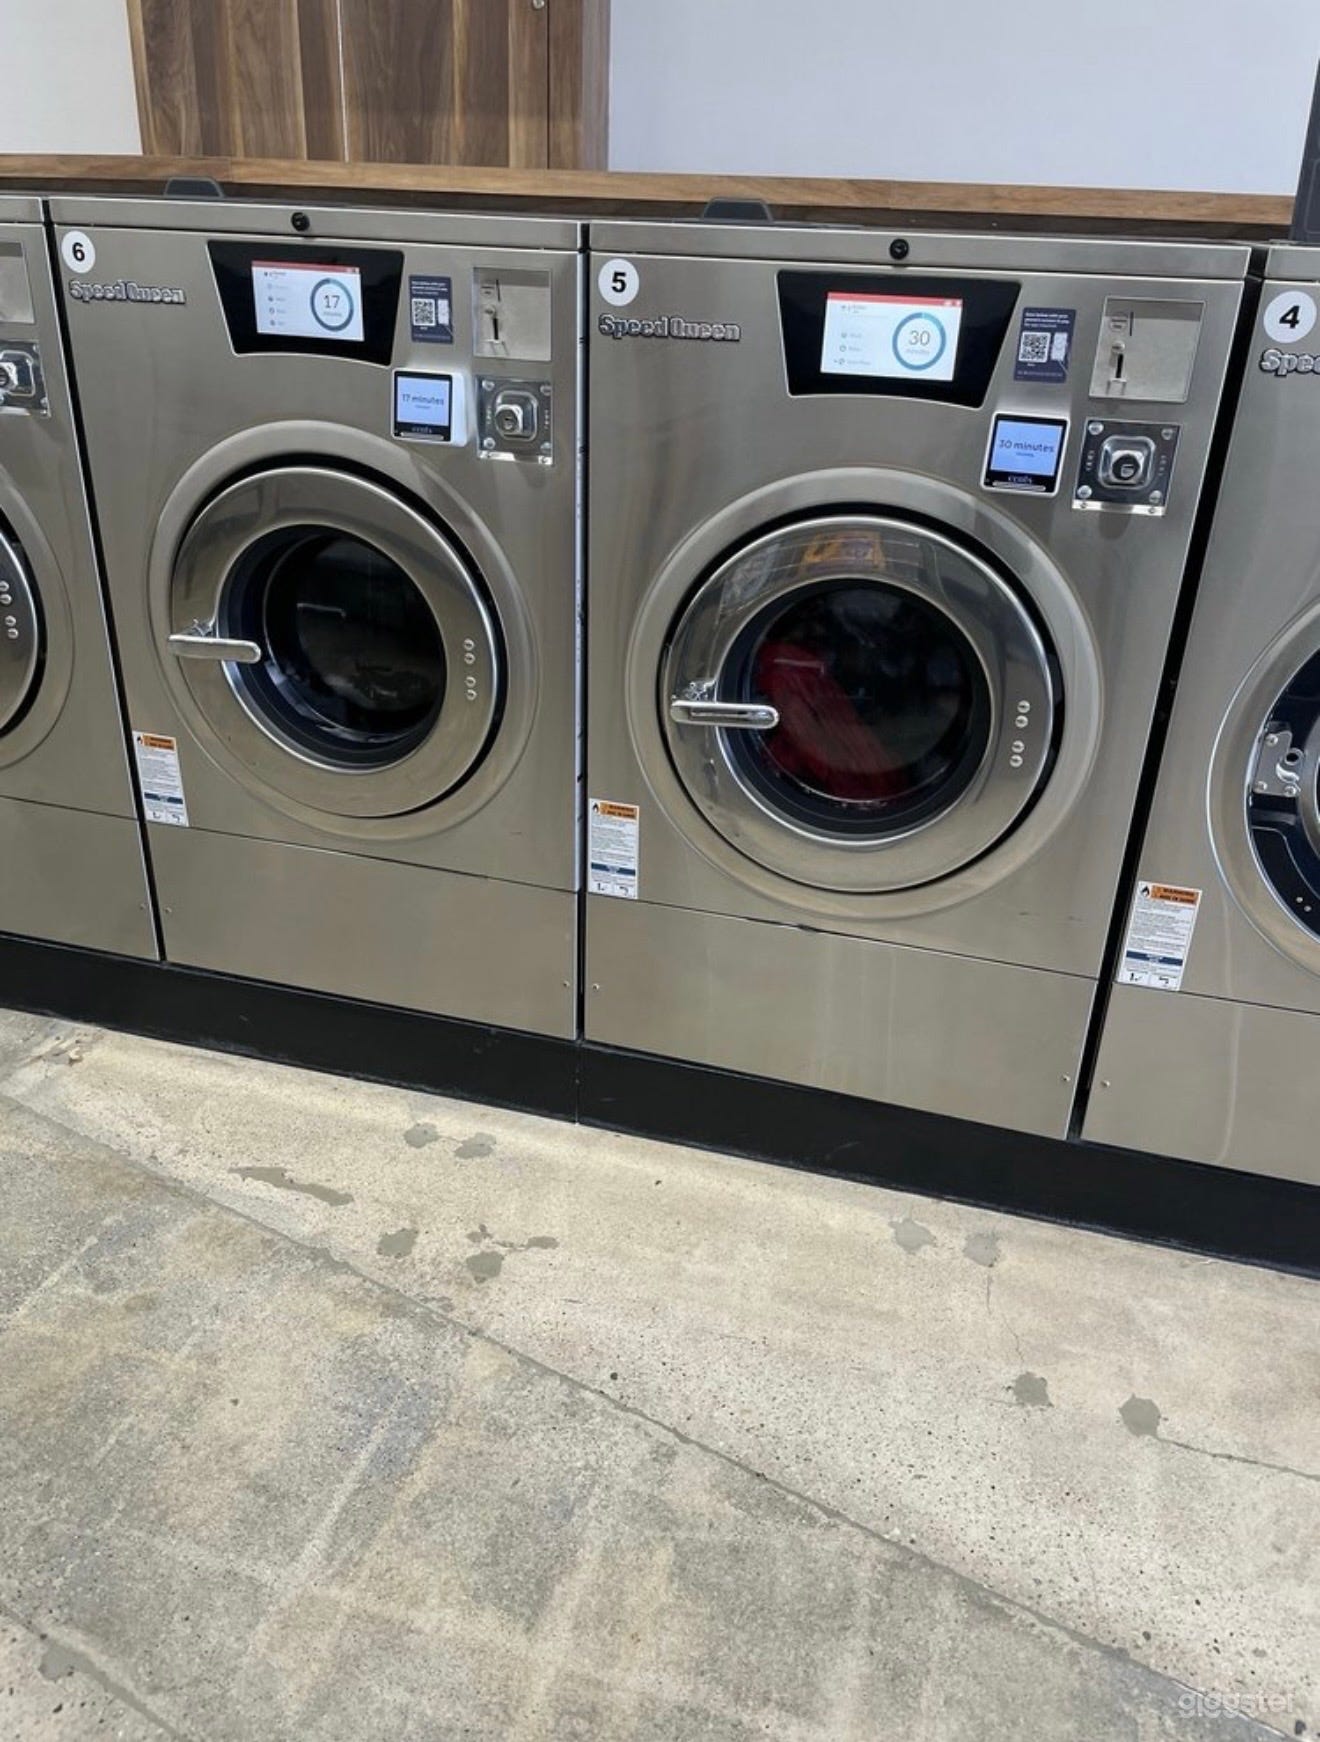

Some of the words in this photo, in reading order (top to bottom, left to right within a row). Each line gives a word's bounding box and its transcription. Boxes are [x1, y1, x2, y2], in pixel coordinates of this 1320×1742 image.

[71, 242, 85, 261] 6
[611, 271, 627, 293] 5
[69, 279, 127, 303] Speed
[126, 281, 186, 305] Queen
[323, 295, 341, 309] 17
[1279, 305, 1300, 329] 4
[599, 313, 669, 340] Speed
[668, 315, 741, 342] Queen
[908, 330, 930, 346] 30
[402, 393, 411, 402] 17
[412, 394, 445, 406] minutes
[1013, 441, 1055, 453] minutes
